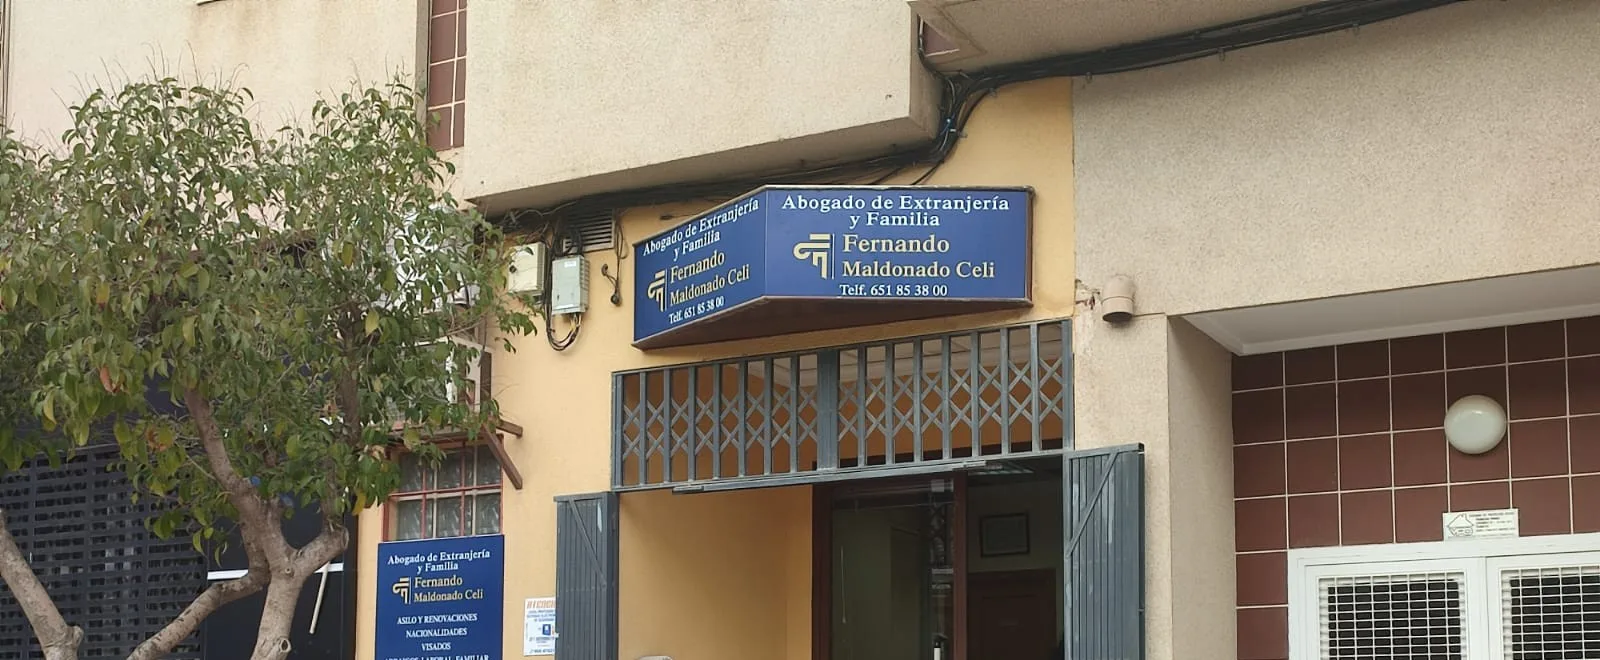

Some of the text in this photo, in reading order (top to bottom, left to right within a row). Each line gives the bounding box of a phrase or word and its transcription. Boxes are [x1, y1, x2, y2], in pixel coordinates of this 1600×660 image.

[782, 195, 1009, 213] Abogado de Extranjería
[643, 198, 759, 257] Abogado de Extranjería
[849, 212, 940, 229] y Familia
[673, 230, 721, 262] y Familia
[842, 234, 950, 253] Fernando
[670, 249, 725, 284] Fernando
[842, 261, 995, 278] Maldonado Celi
[670, 264, 750, 307] Maldonado Celi
[839, 284, 948, 296] Telf. 651 85 38 00
[668, 295, 724, 324] Telf. 651 85 38 00
[388, 549, 490, 565] Abogado de Extranjería
[417, 561, 459, 575] y Familia
[414, 575, 463, 588] Fernando
[414, 589, 484, 602] Maldonado Celi
[397, 613, 478, 624] ASILO Y RENOVACIONES
[406, 628, 468, 638] NACIONALIDADES
[421, 642, 451, 651] VISADOS
